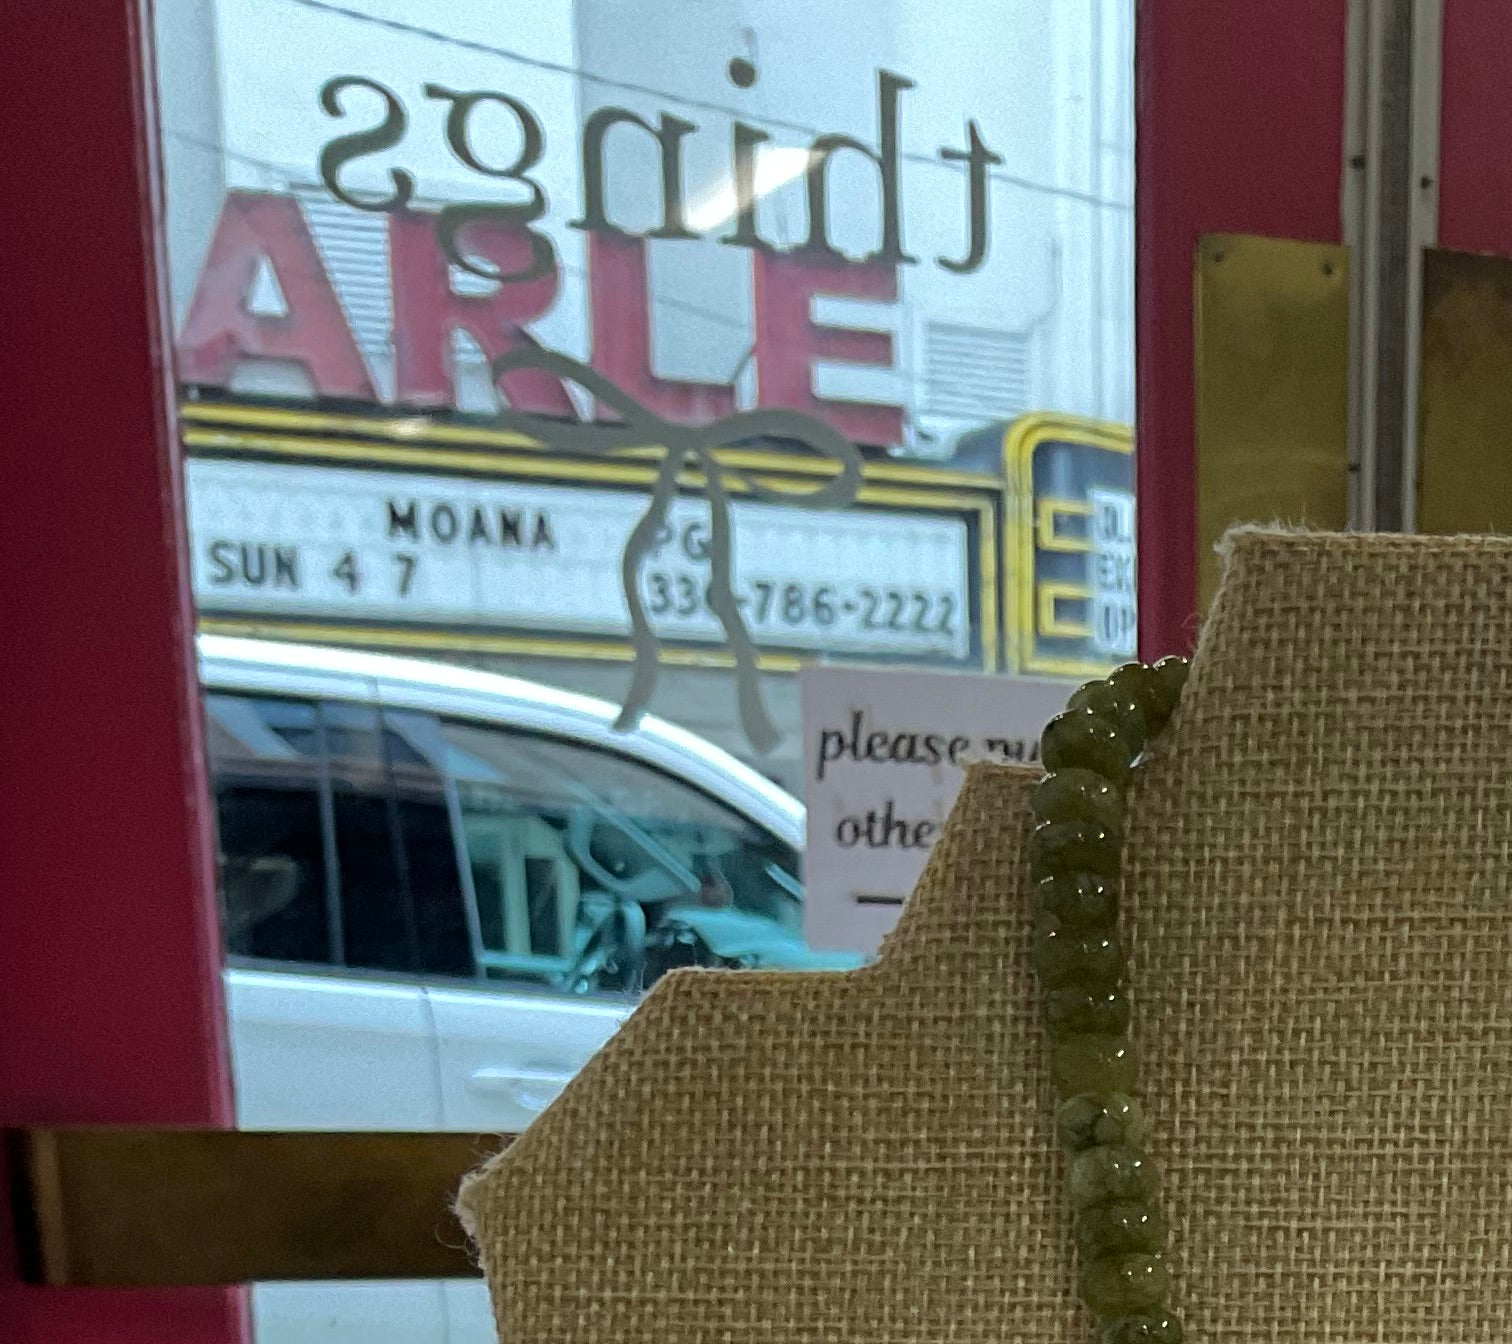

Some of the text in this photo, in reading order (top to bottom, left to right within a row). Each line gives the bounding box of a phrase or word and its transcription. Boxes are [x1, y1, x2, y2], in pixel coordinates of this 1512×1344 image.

[385, 500, 557, 549] MOANA
[208, 538, 956, 637] SUN 4 7 33-786-2222
[816, 709, 969, 782] please
[836, 799, 944, 849] othe
